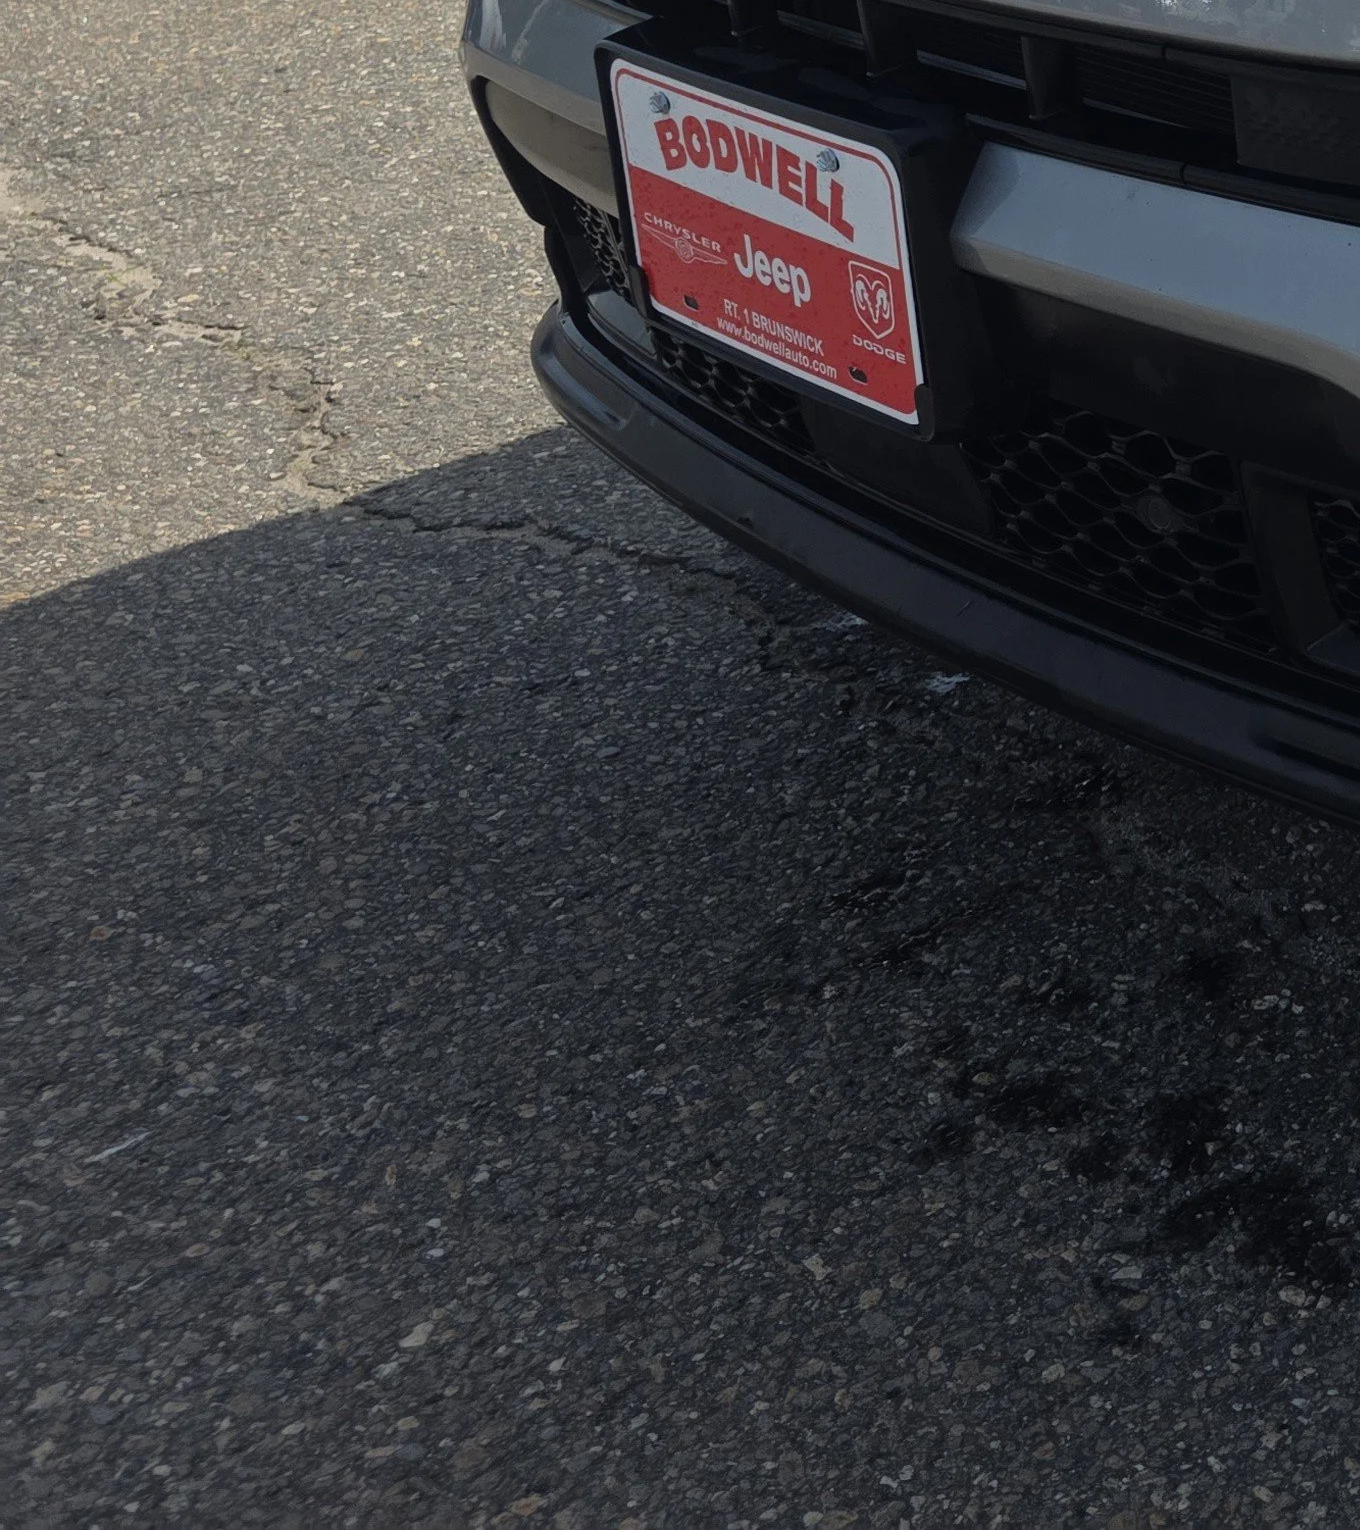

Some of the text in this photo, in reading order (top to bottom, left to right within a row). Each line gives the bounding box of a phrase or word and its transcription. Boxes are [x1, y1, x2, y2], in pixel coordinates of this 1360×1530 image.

[654, 115, 855, 243] BODWELL
[643, 212, 722, 253] CHRYSLER
[733, 234, 811, 307] Jeep
[717, 317, 838, 379] www.bodwellauto.com
[723, 298, 824, 357] RT. 1 BRUNSWICK
[852, 334, 907, 365] DODGE
